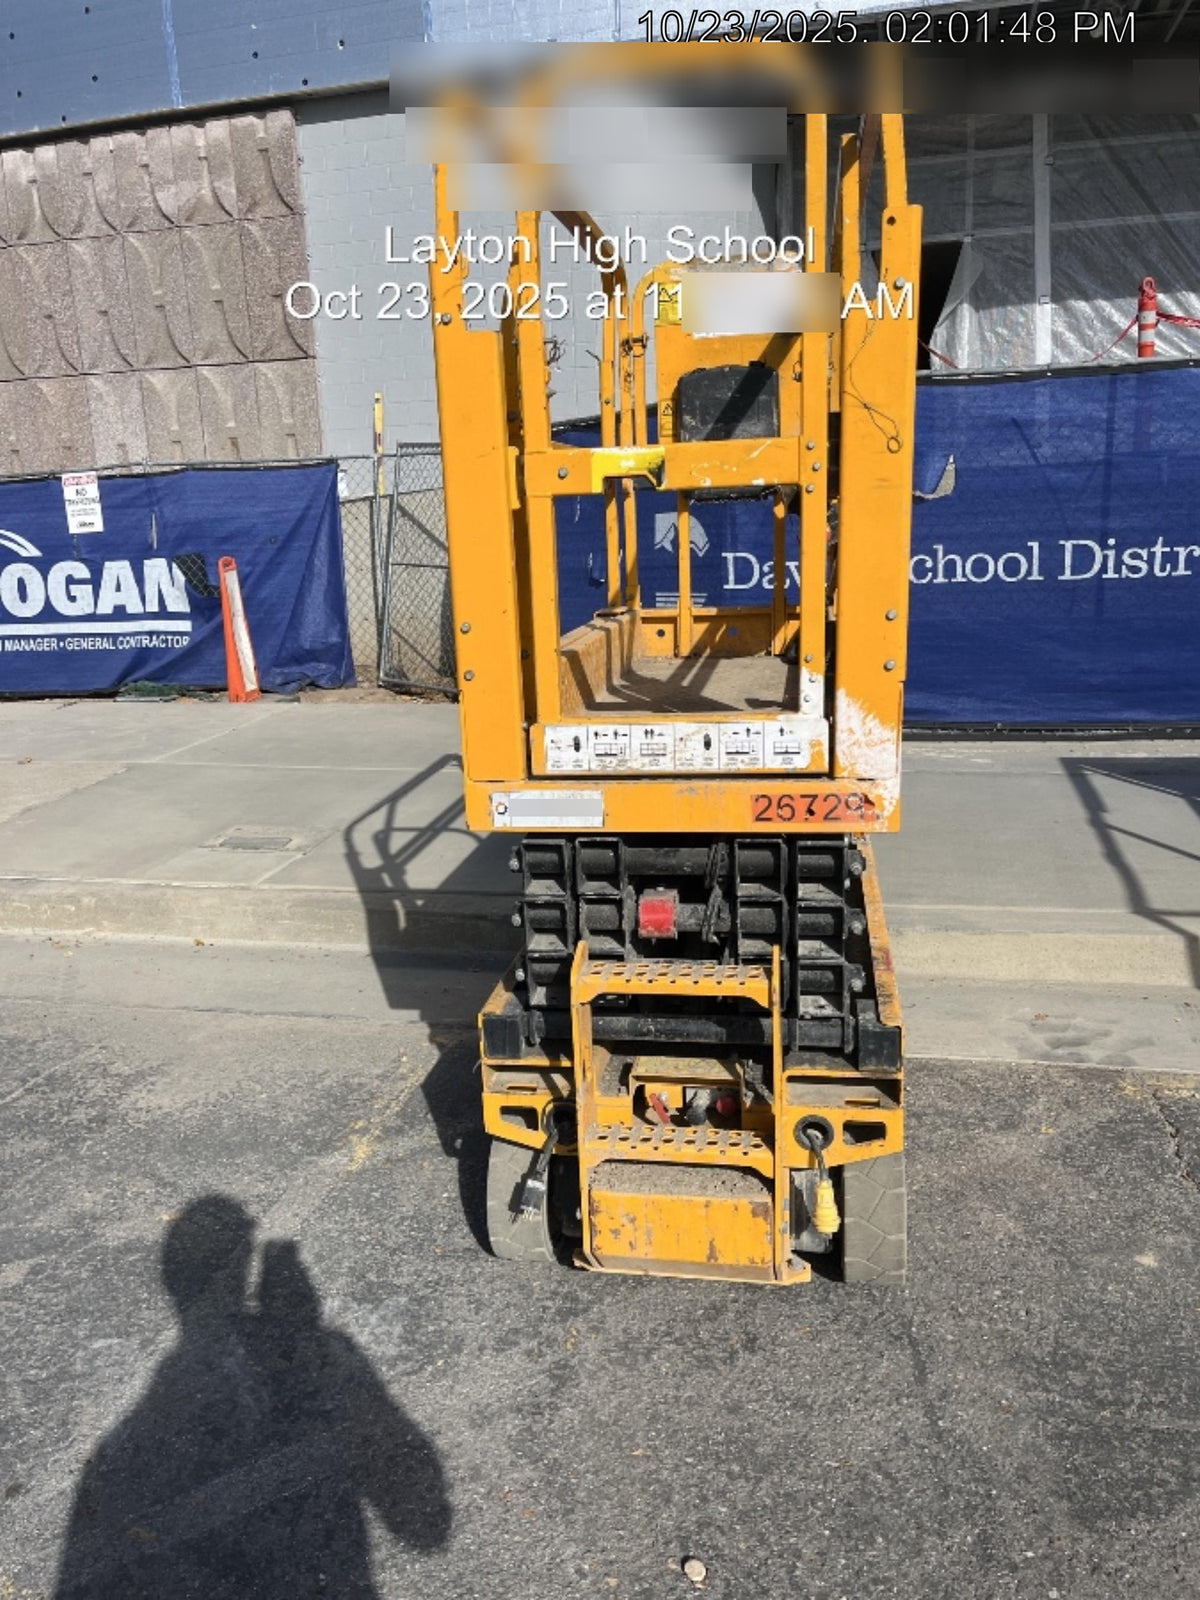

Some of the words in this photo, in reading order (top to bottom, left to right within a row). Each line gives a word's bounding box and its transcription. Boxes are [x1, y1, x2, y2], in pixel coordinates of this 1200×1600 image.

[0, 557, 192, 618] OGAN
[721, 552, 803, 590] Dav
[908, 541, 1045, 585] chool
[1058, 536, 1200, 581] Distr
[754, 792, 865, 822] 26729
